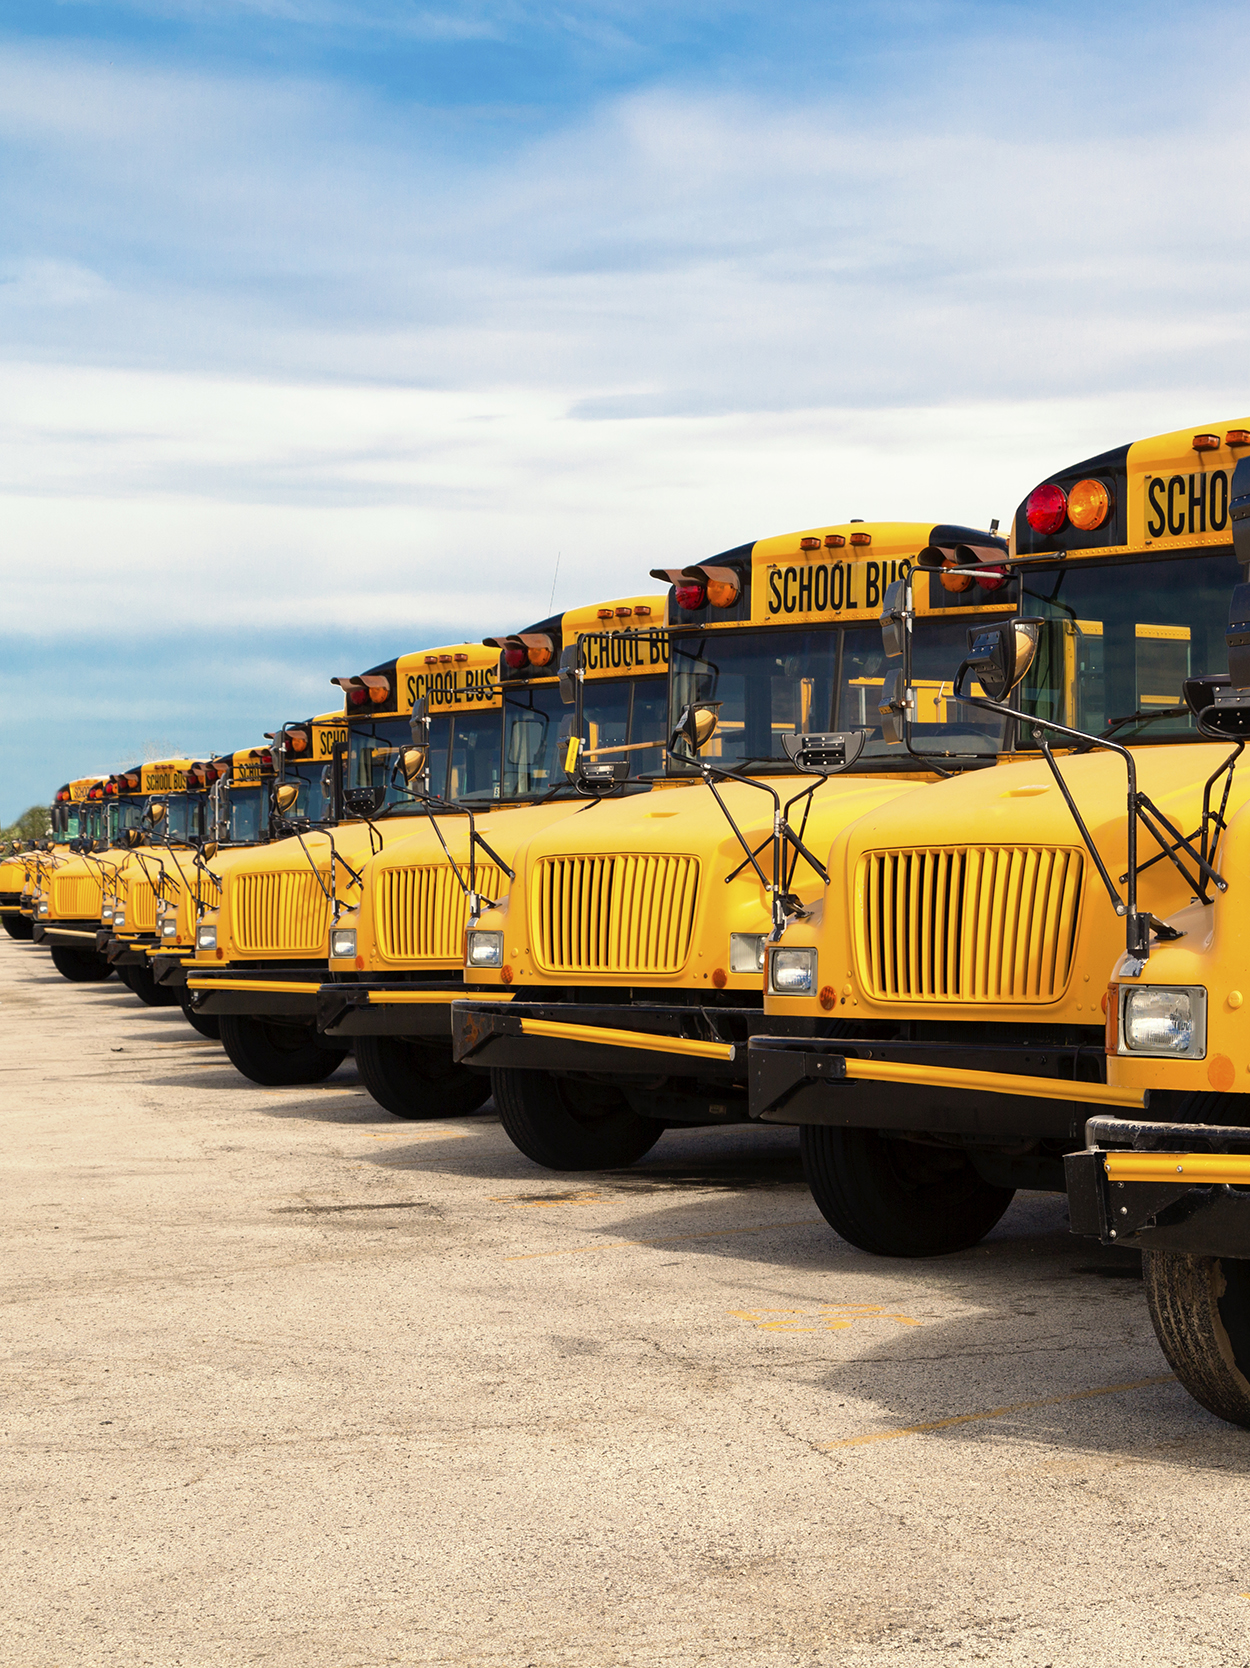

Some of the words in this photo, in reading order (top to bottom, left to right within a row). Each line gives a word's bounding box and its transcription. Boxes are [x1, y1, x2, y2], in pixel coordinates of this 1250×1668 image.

[1148, 469, 1230, 538] SCHO
[768, 563, 858, 614] SCHOOL
[577, 628, 644, 669] SCHOOL
[650, 627, 669, 665] BU
[407, 671, 462, 707] SCHOOL
[466, 668, 494, 702] BUS
[320, 729, 347, 755] SCHO
[146, 773, 172, 791] SCHOOL
[174, 773, 186, 790] BUS
[239, 762, 260, 782] SCHO
